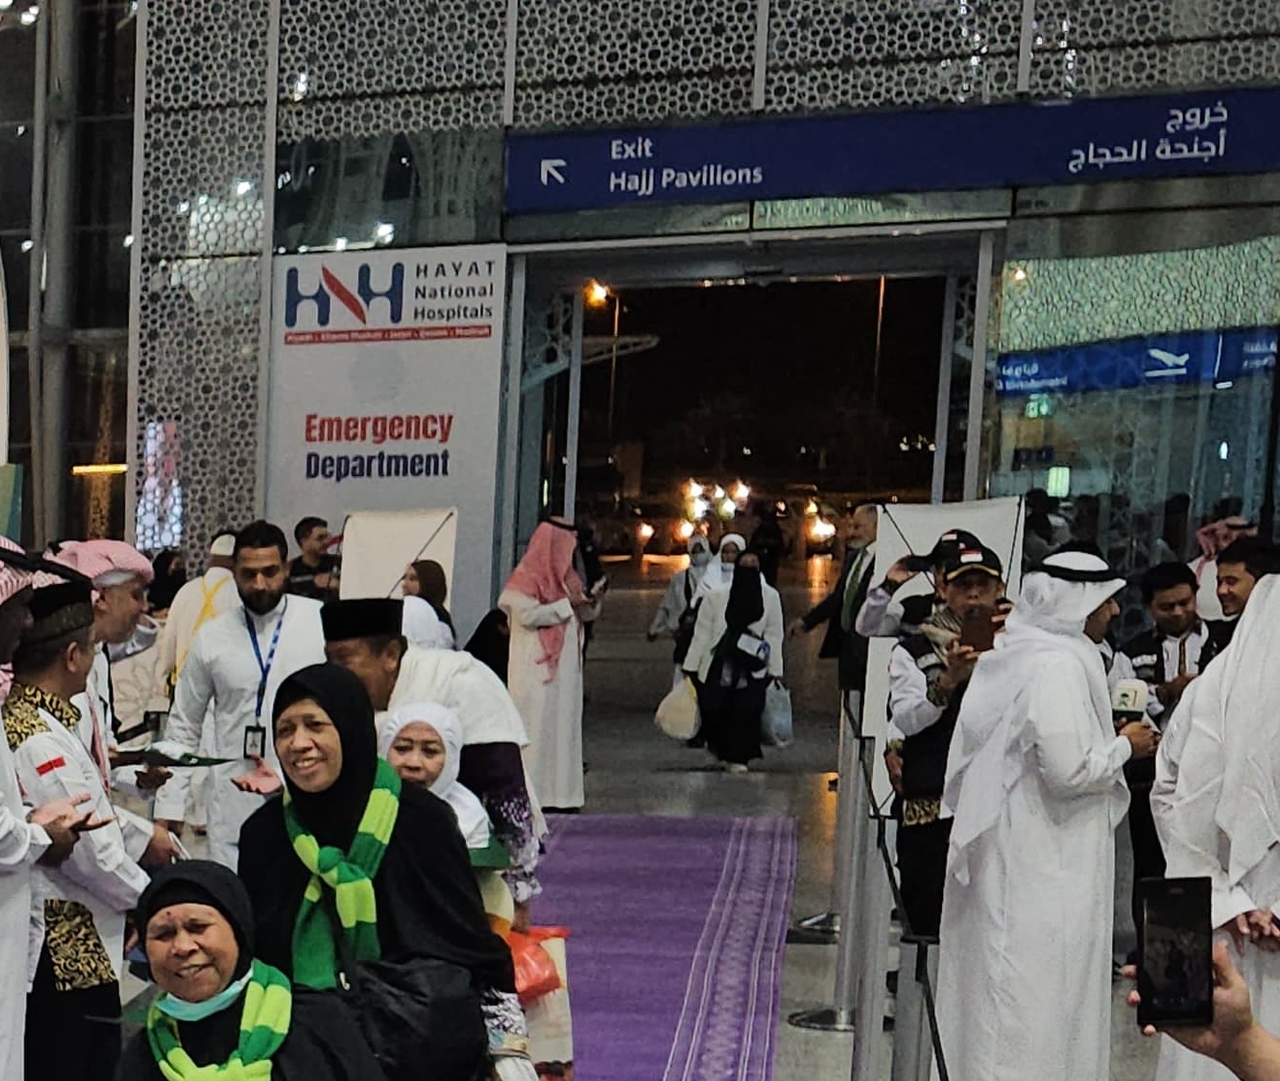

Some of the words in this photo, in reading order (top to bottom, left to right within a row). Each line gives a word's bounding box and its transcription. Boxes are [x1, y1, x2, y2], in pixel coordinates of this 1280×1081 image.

[1166, 101, 1228, 132] خروج
[611, 137, 653, 159] Exit
[1068, 139, 1147, 173] الحجاج
[1155, 128, 1226, 162] أجنحة
[610, 168, 654, 196] Hajj
[661, 164, 763, 188] Pavilions
[415, 261, 495, 279] HAYAT
[414, 283, 493, 300] National
[413, 303, 493, 322] Hospitals
[305, 414, 454, 444] Emergency
[306, 449, 450, 483] Department
